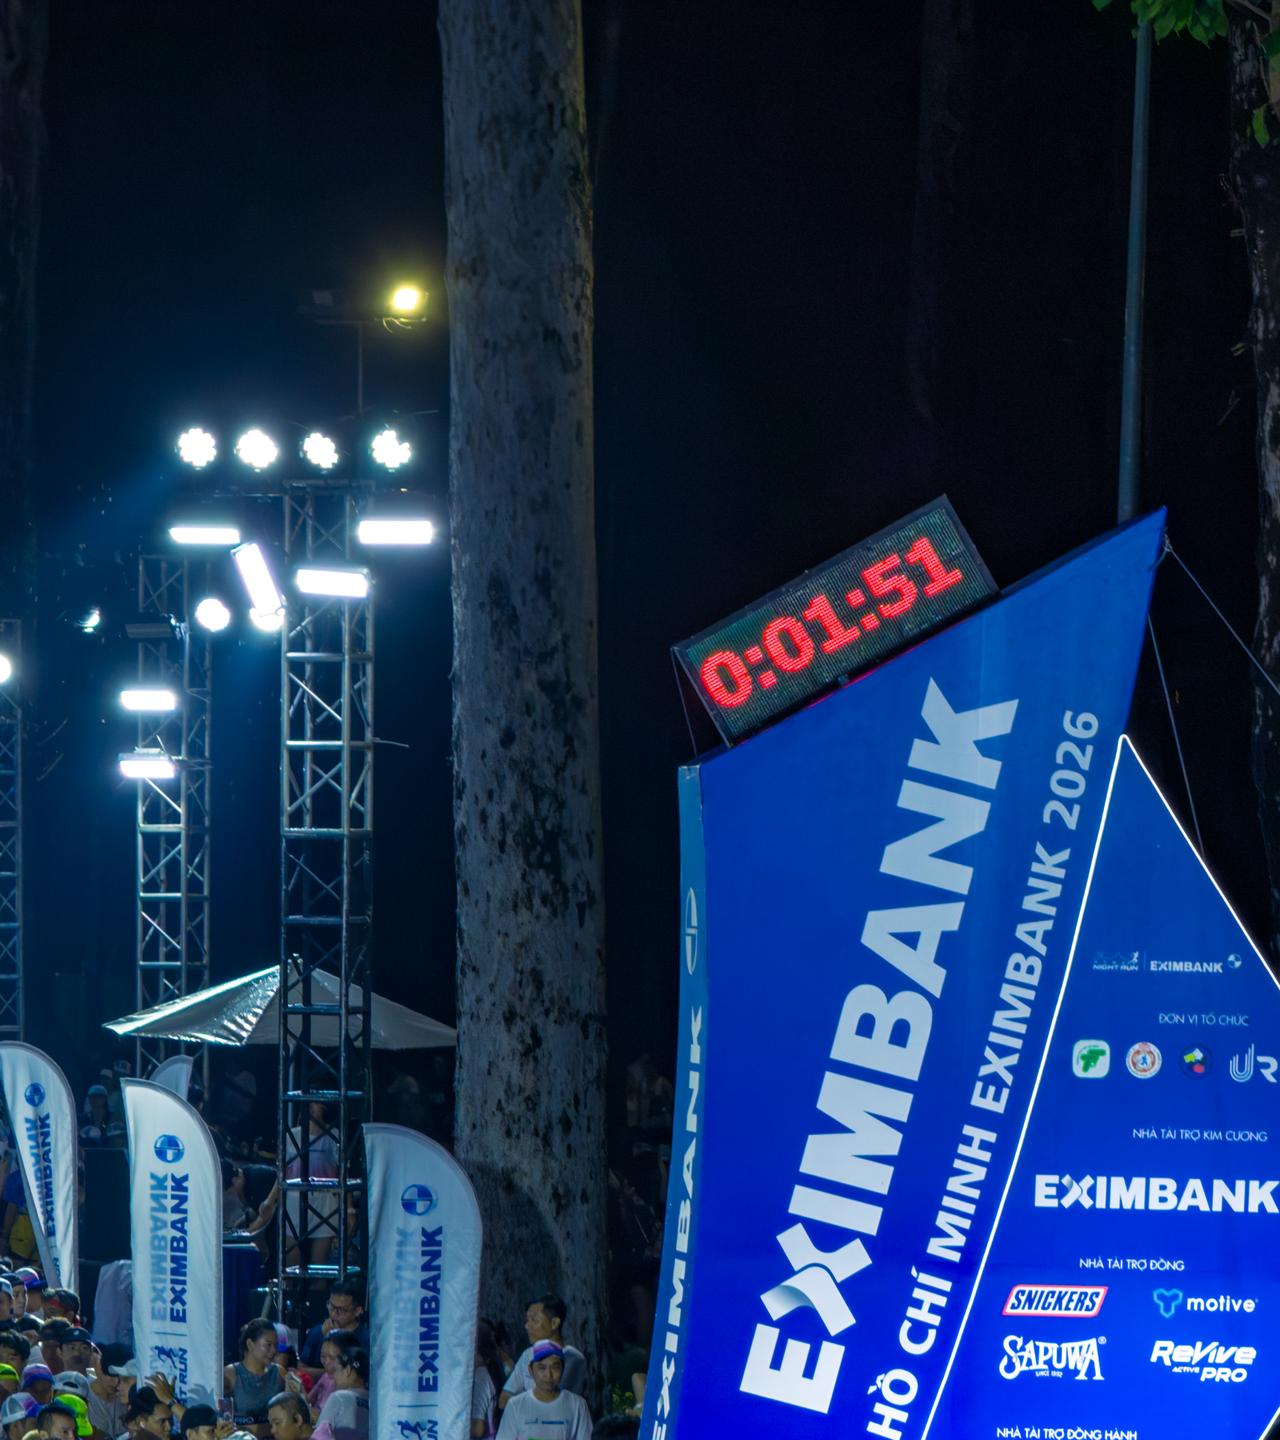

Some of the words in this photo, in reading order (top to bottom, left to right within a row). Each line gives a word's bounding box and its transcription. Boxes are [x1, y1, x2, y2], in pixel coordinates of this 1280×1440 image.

[699, 537, 963, 708] 0:01:51
[1042, 710, 1100, 831] 2026
[970, 842, 1072, 1115] EXIMBANK
[1150, 960, 1223, 974] EXIMBANK
[739, 676, 1019, 1415] EXIMBANK
[1203, 1130, 1223, 1141] KIM
[925, 1124, 999, 1264] MINH
[1034, 1174, 1280, 1214] EXIMBANK
[168, 1172, 189, 1324] EXIMBANK
[417, 1225, 444, 1393] EXIMBANK
[898, 1266, 953, 1356] CHÍ
[1010, 1289, 1100, 1313] SNICKERS
[1187, 1295, 1256, 1313] motive
[999, 1335, 1105, 1380] SAPUWA
[1200, 1367, 1248, 1383] PRO
[996, 1426, 1022, 1439] NHÀ
[1024, 1427, 1040, 1440] TÀI
